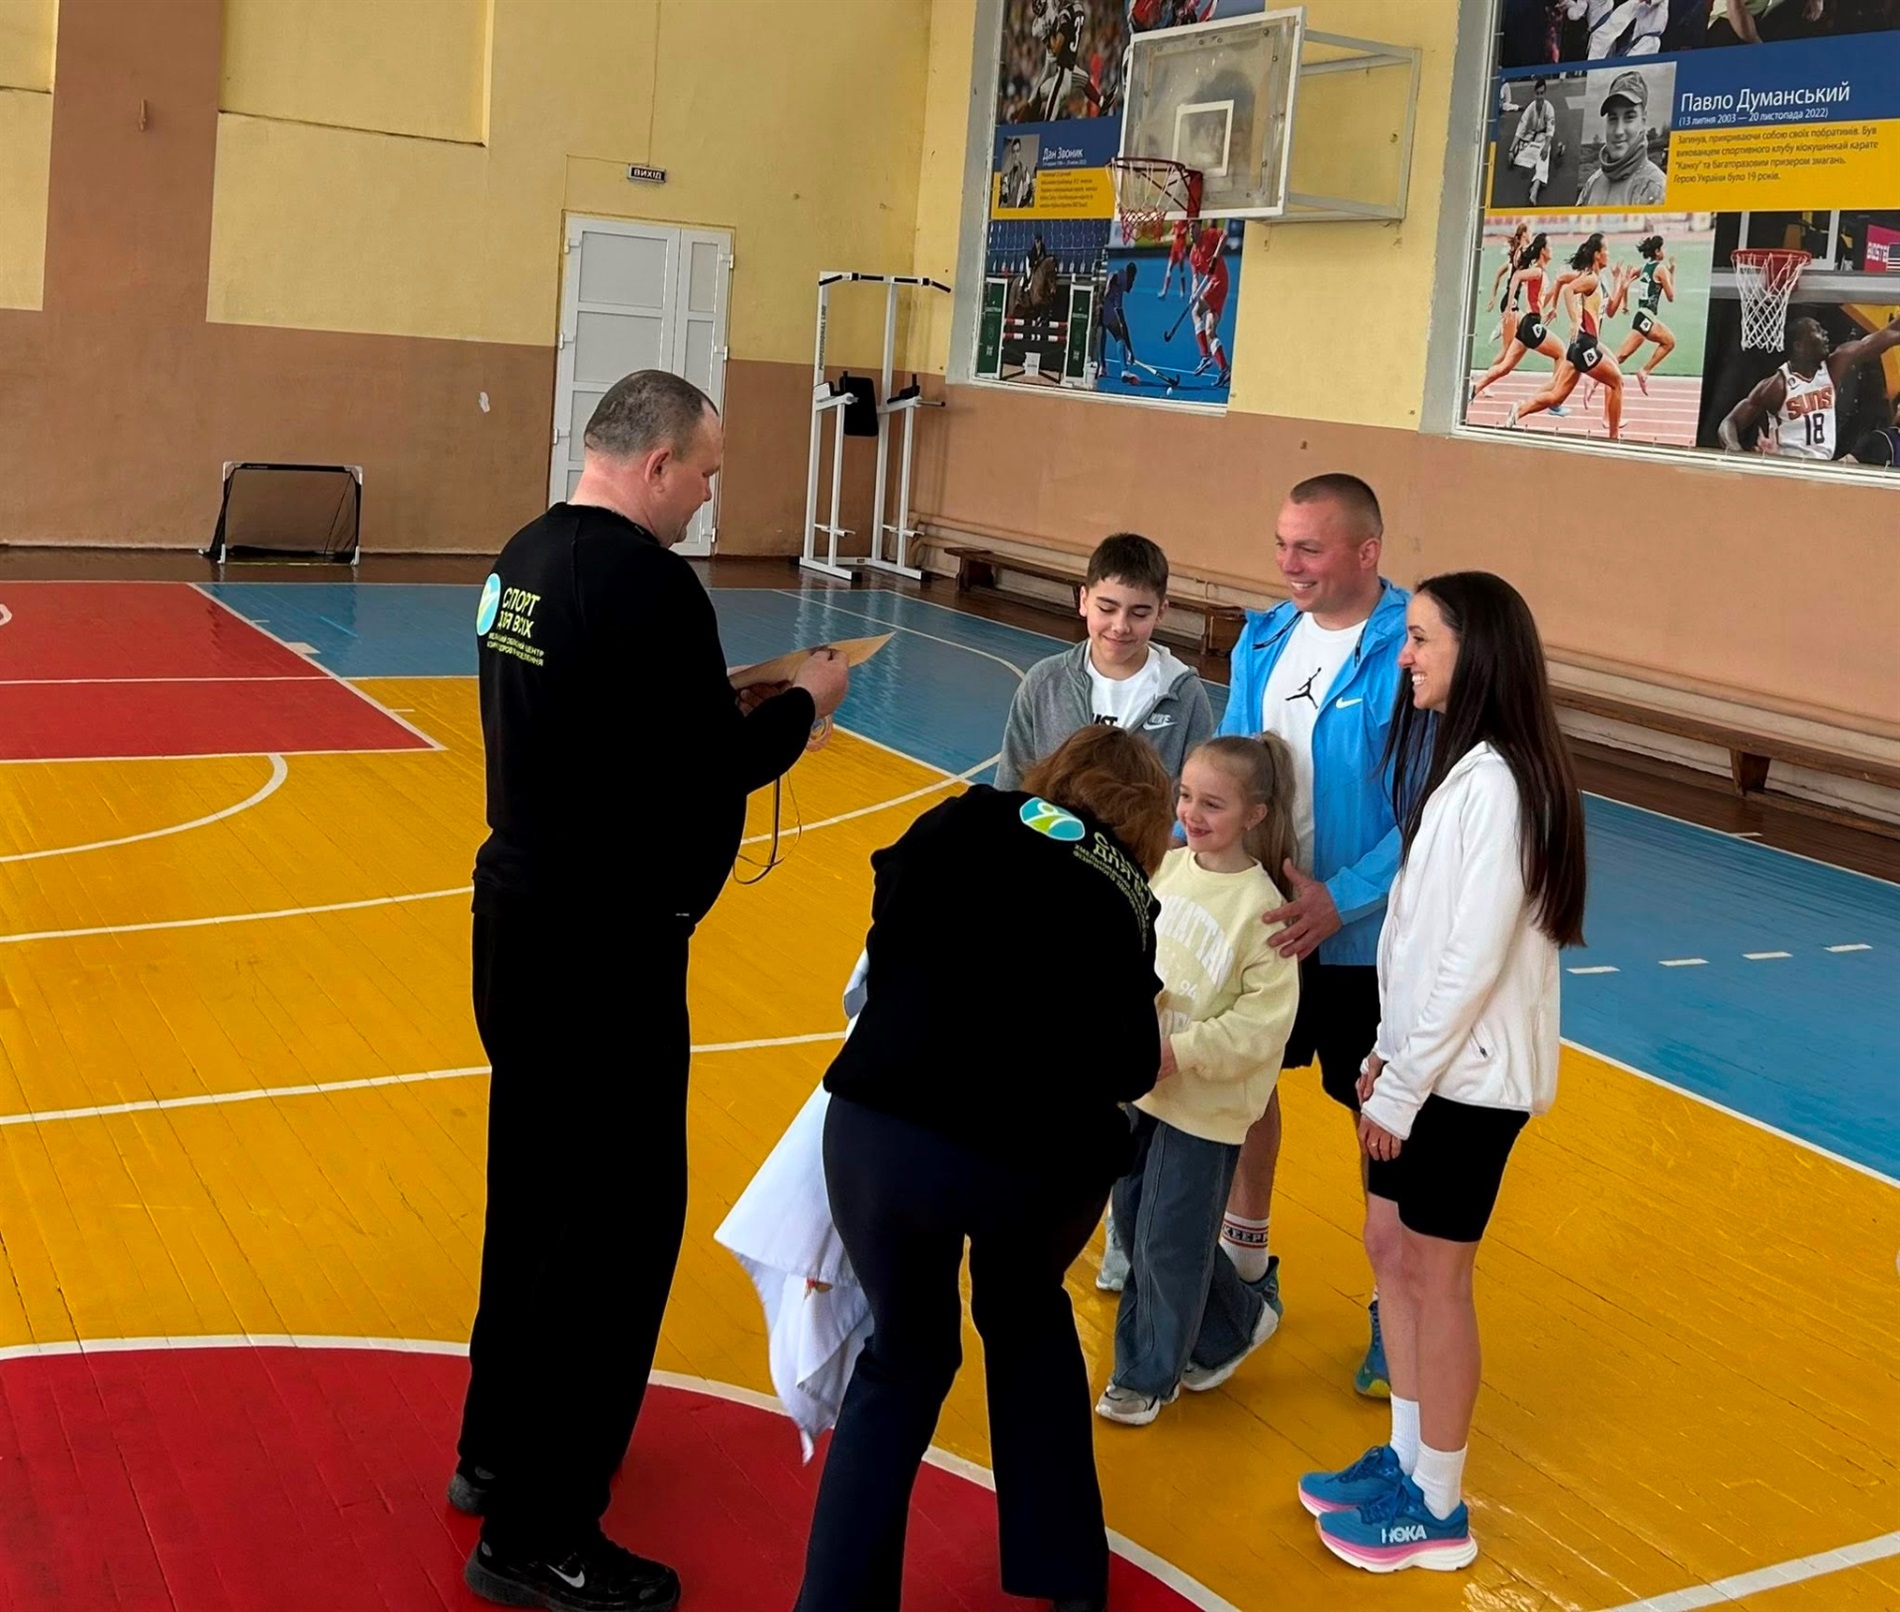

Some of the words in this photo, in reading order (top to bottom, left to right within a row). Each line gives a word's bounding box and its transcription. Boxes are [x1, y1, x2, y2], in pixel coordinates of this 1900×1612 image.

[1681, 92, 1733, 112] Павло
[1736, 81, 1850, 113] Думанський
[1679, 117, 1690, 127] (13
[1717, 113, 1736, 124] 2003
[1749, 112, 1759, 122] 20
[1759, 110, 1803, 122] листопада
[1804, 107, 1829, 119] 2022)
[1761, 130, 1788, 140] собою
[1862, 125, 1877, 137] Був
[1721, 146, 1770, 156] спортивного
[1771, 143, 1794, 154] клубу
[1849, 141, 1879, 151] карате
[633, 168, 662, 180] ВИХІД
[1674, 174, 1697, 184] Герою
[1727, 172, 1746, 183] було
[1747, 171, 1757, 180] 19
[1786, 386, 1832, 421] SUNS
[1804, 412, 1825, 446] 18
[502, 586, 541, 617] СПОРТ
[1381, 1524, 1428, 1544] HOKA
